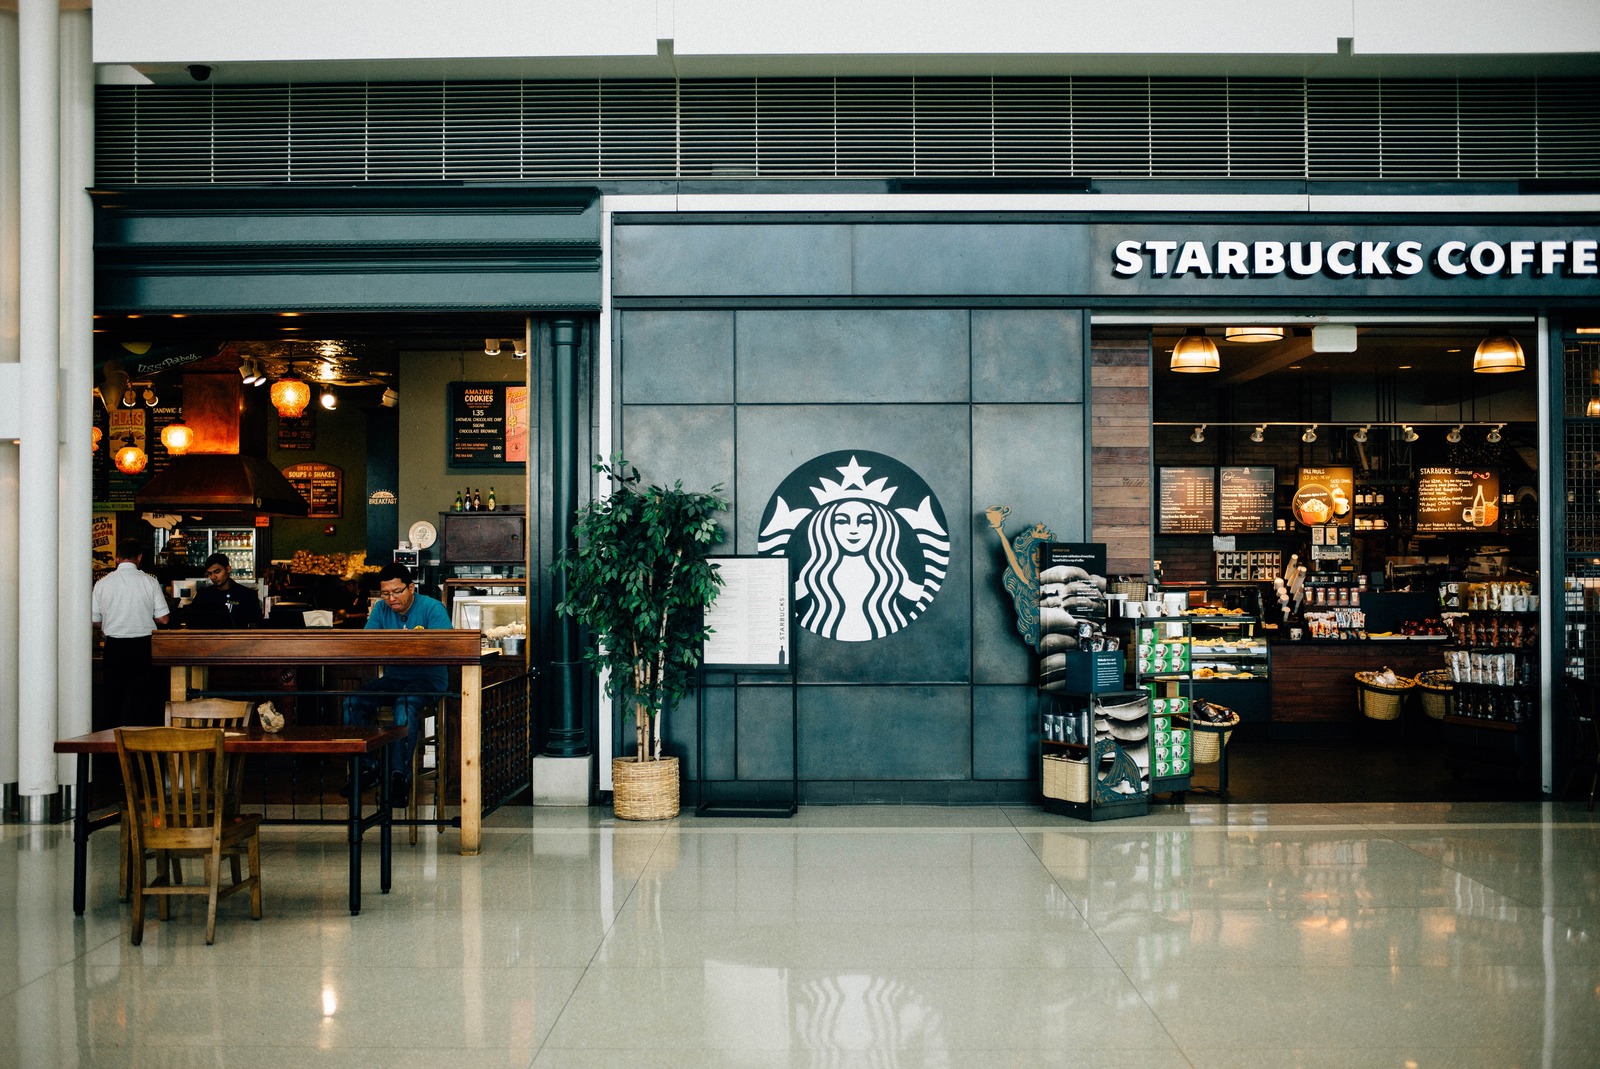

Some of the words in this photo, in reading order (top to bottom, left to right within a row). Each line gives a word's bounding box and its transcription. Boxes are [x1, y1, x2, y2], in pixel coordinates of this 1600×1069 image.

[1114, 240, 1424, 276] STARBUCKS
[1436, 240, 1598, 276] COFFE
[112, 412, 142, 426] FLATS
[368, 497, 397, 505] BREAKFAST
